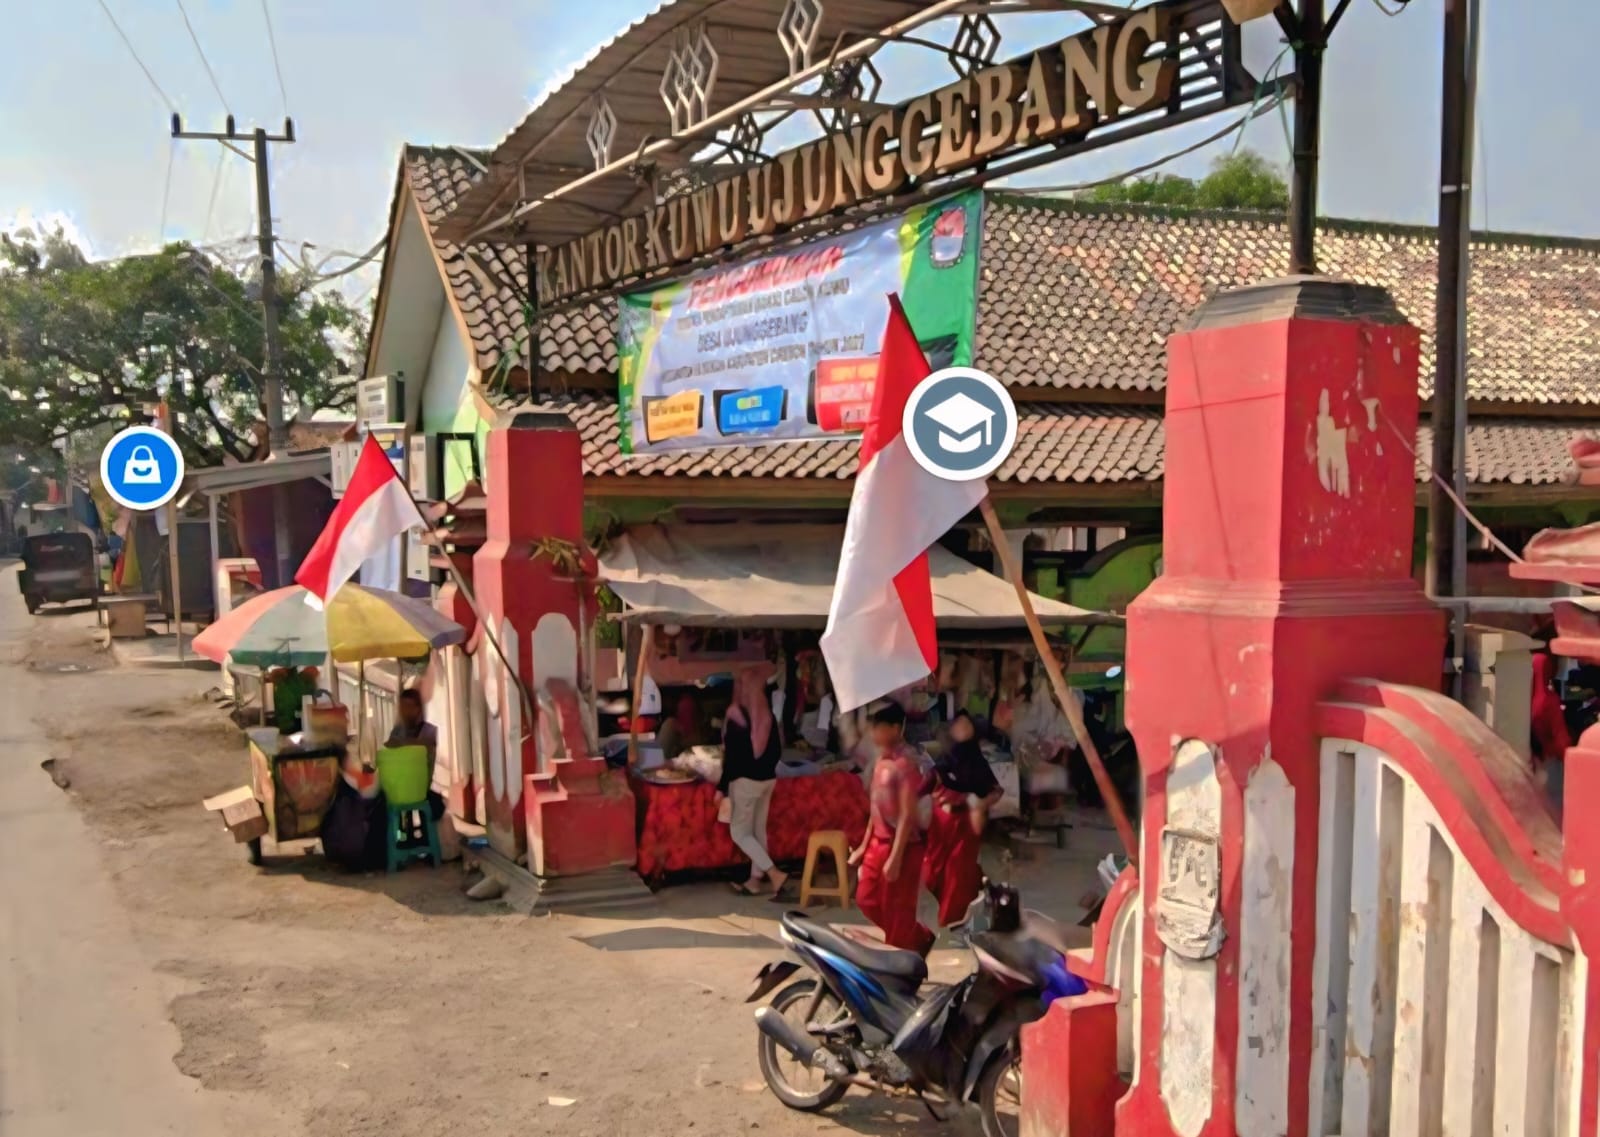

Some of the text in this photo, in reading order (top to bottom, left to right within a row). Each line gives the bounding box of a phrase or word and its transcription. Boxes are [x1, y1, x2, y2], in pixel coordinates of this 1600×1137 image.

[536, 6, 1163, 302] KANTOR KUWU UJUNGGEBANG
